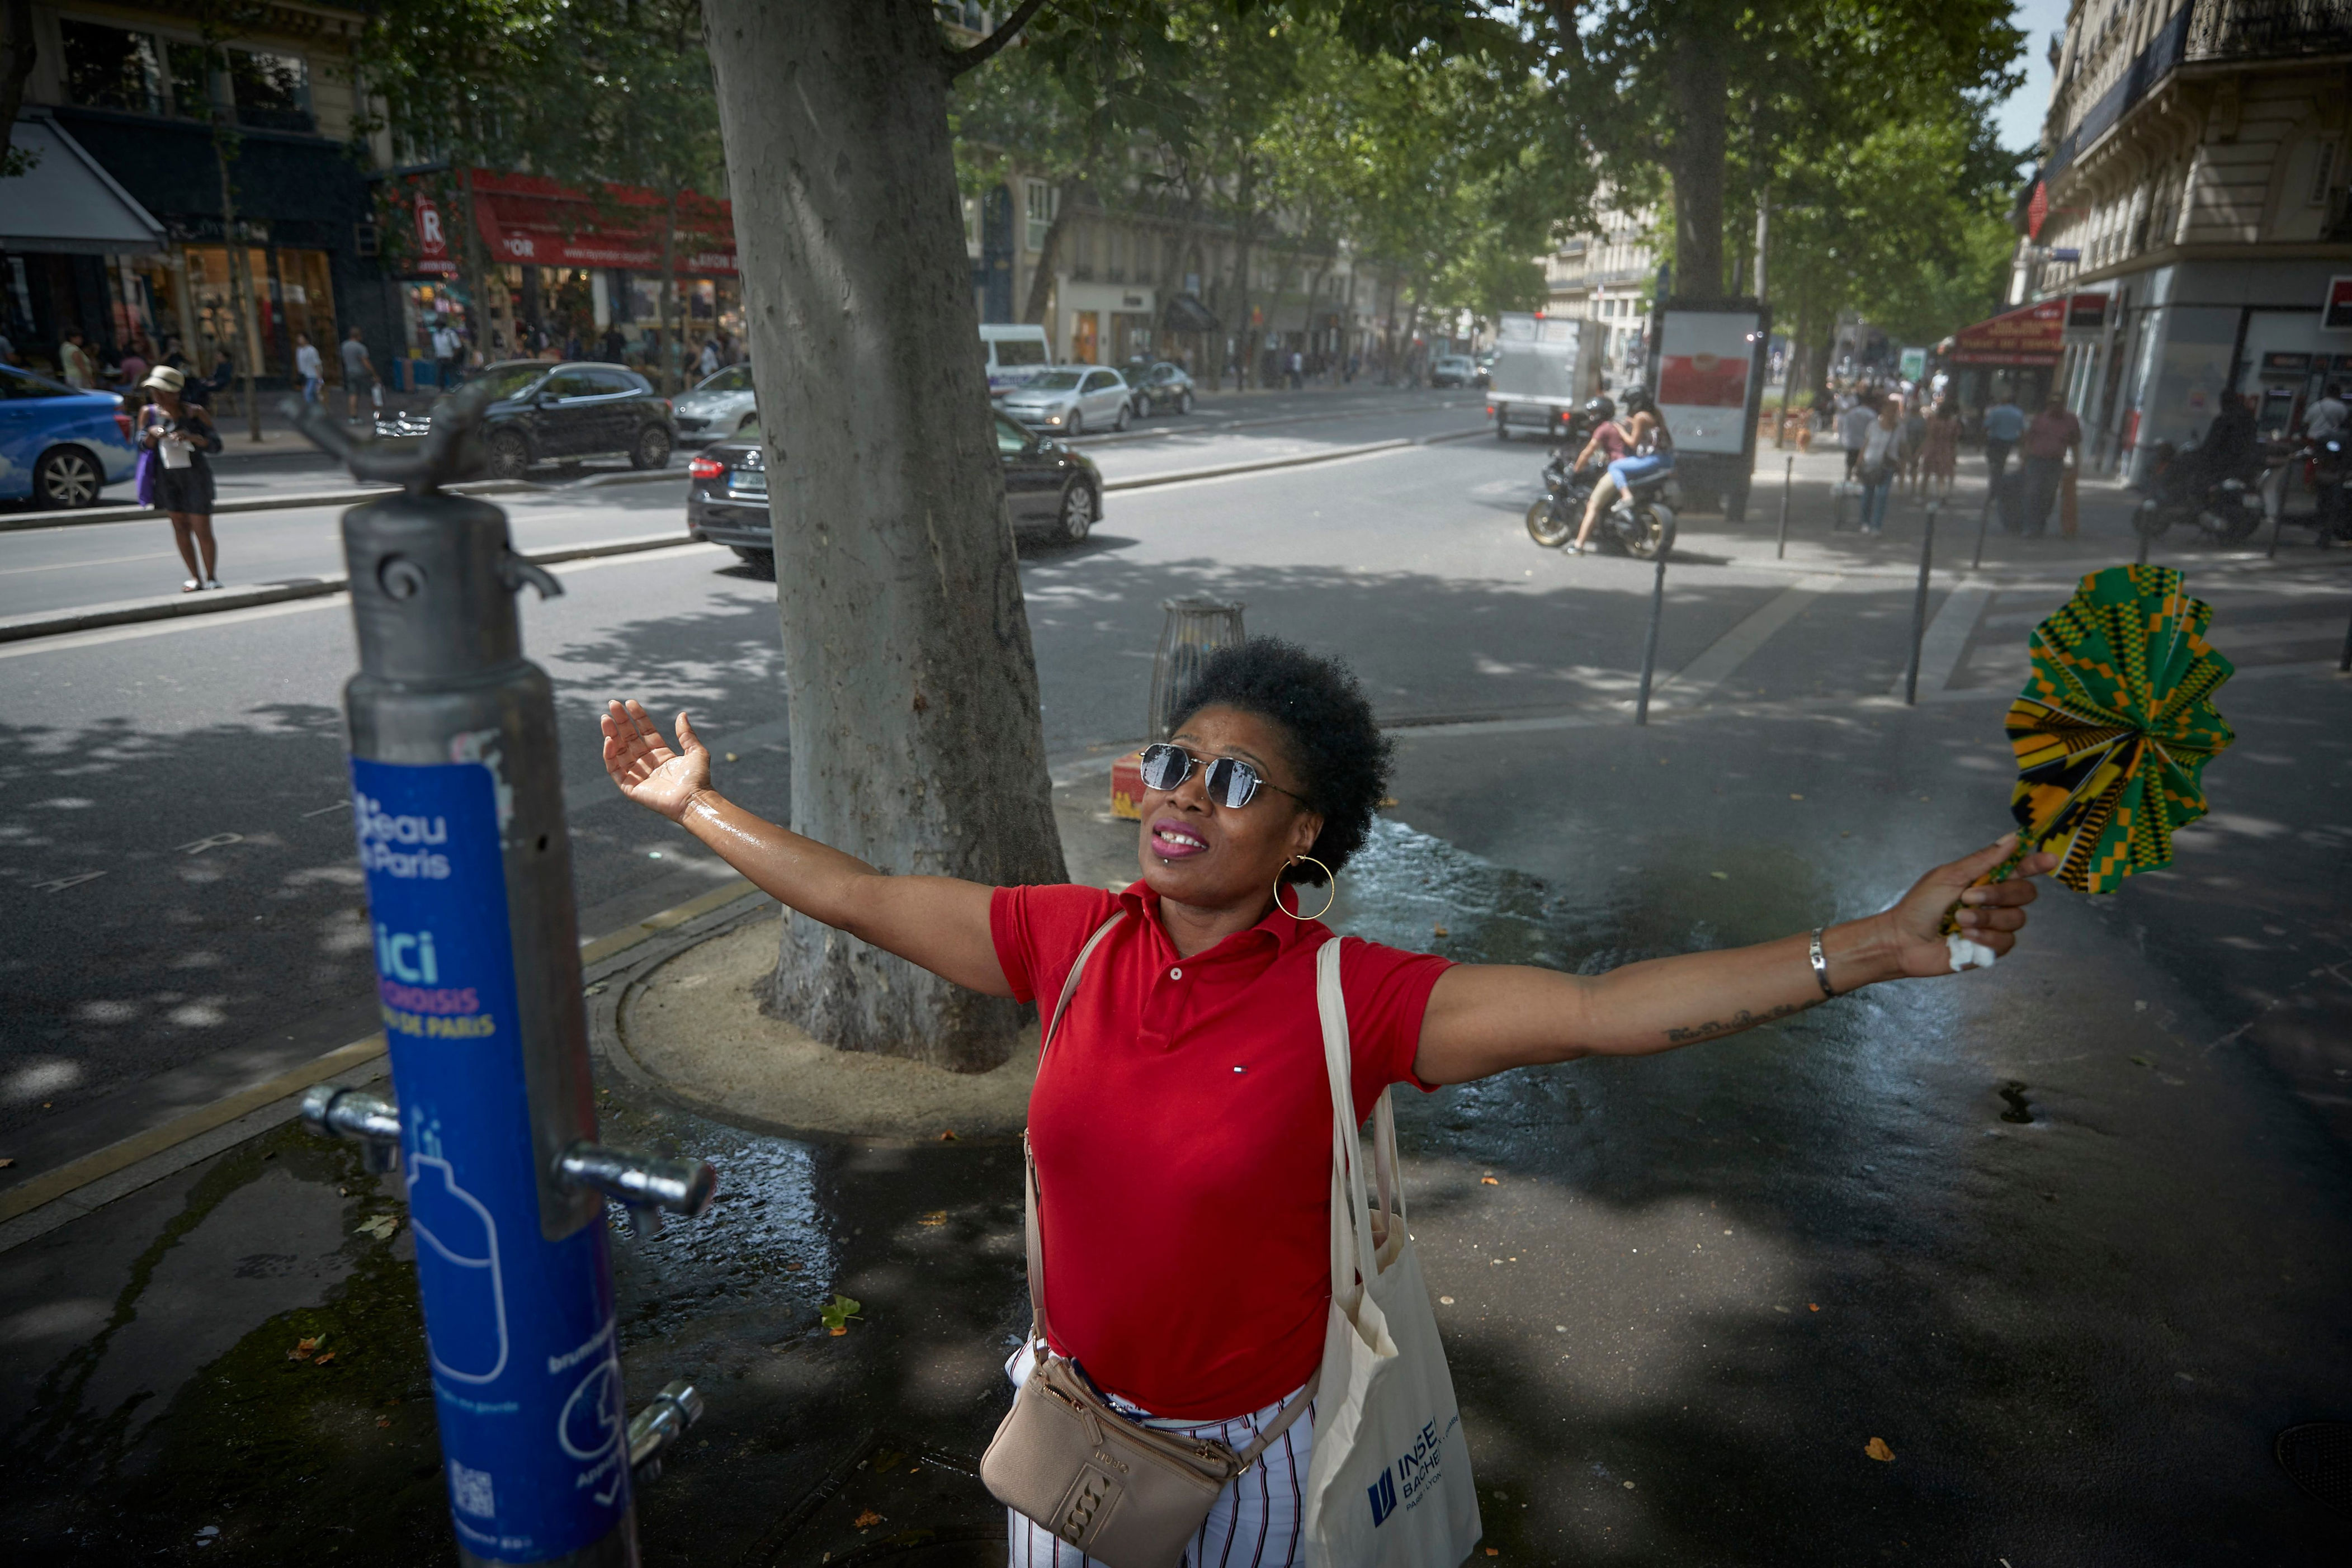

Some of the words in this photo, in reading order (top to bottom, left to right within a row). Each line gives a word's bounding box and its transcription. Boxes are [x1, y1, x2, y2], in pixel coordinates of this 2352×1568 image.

[422, 210, 443, 243] R
[373, 842, 451, 880] Paris
[1397, 1416, 1438, 1481] INSE
[1402, 1446, 1442, 1499] BACHE
